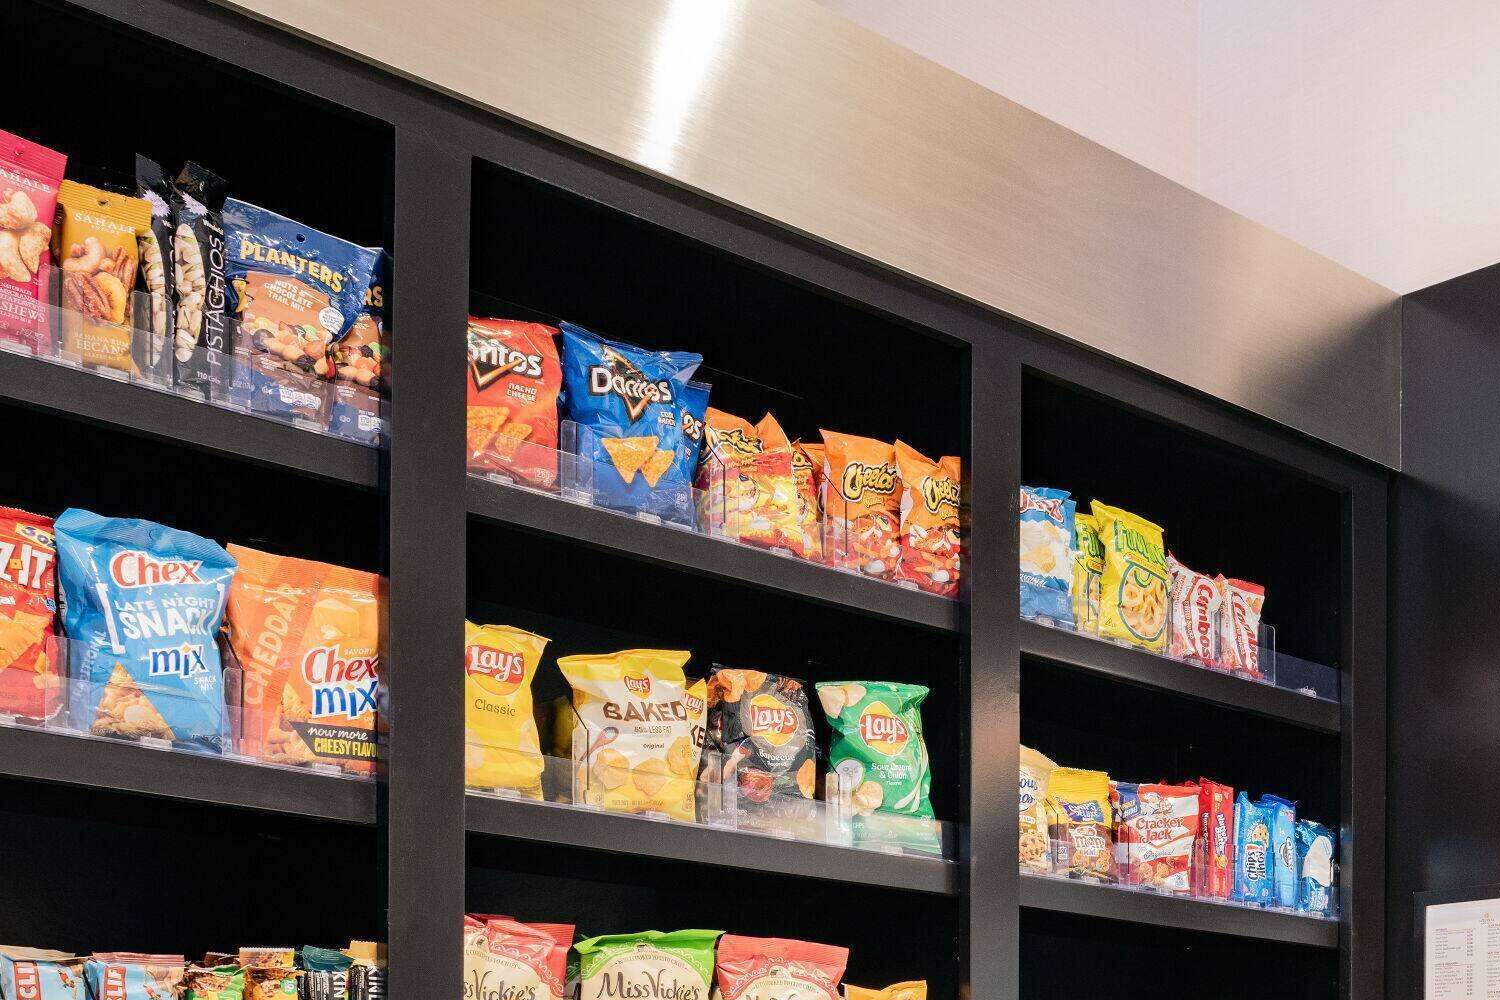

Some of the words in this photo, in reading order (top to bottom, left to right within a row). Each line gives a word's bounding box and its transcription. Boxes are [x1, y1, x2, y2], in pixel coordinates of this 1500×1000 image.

[0, 167, 51, 193] AHALE
[74, 212, 136, 235] SAHALE
[239, 237, 345, 293] PLANTERS
[264, 282, 313, 309] CHOCOLATE
[274, 279, 299, 293] NUTS
[206, 234, 225, 366] PISTACHIOS
[267, 291, 291, 306] TRAIL
[289, 301, 305, 313] MIX
[468, 335, 543, 377] oritos
[506, 389, 537, 402] CHEESE
[508, 382, 538, 395] NACHO
[590, 366, 672, 403] Doritos
[842, 463, 897, 503] Cheetos
[110, 551, 203, 588] Chex
[114, 600, 157, 612] LATE
[163, 593, 216, 609] NIGHT
[1197, 584, 1214, 664] Combos
[149, 645, 209, 679] mix
[302, 645, 378, 685] Chex
[471, 645, 525, 682] Lay's
[626, 676, 651, 693] Lay's
[312, 680, 378, 719] mix
[474, 698, 516, 717] Classic
[602, 700, 688, 722] BAKED
[752, 705, 799, 734] Lay's
[864, 713, 908, 744] Lay's
[307, 726, 337, 738] now
[338, 728, 369, 742] more
[314, 737, 351, 755] CHEESY
[643, 743, 665, 751] original
[1135, 817, 1184, 831] Cracker
[1141, 828, 1173, 844] Jack
[1246, 851, 1259, 882] Chips
[597, 972, 650, 999] Miss
